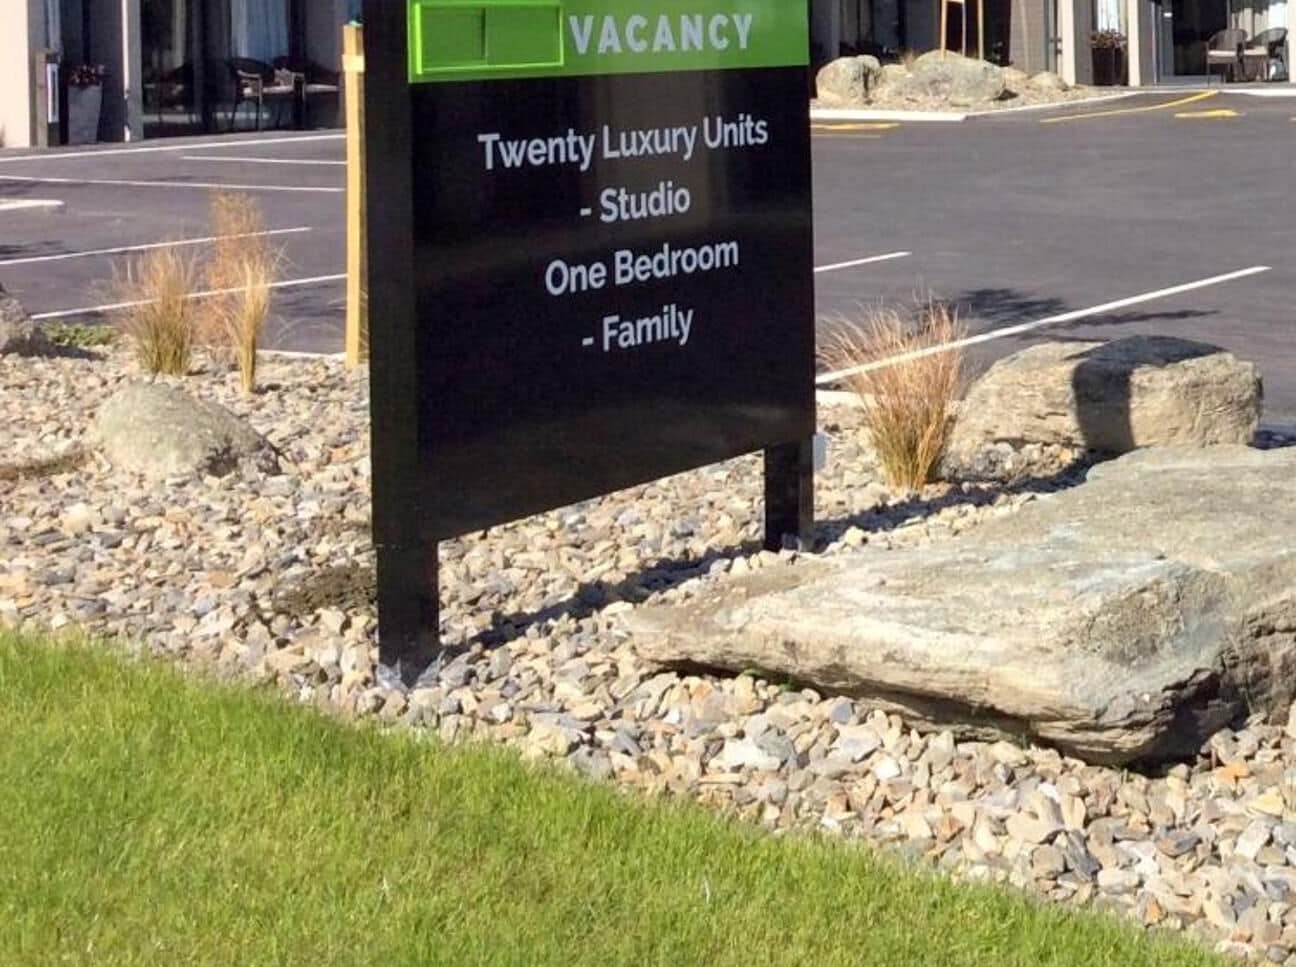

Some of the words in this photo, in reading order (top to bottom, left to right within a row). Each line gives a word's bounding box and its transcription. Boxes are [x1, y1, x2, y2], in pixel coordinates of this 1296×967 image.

[569, 14, 753, 55] VACANCY
[478, 128, 594, 171] Twenty
[602, 125, 696, 159] Luxury
[703, 114, 768, 148] Units
[600, 182, 691, 223] Studio
[545, 260, 607, 296] One
[615, 239, 739, 286] Bedroom
[602, 306, 693, 351] Family
